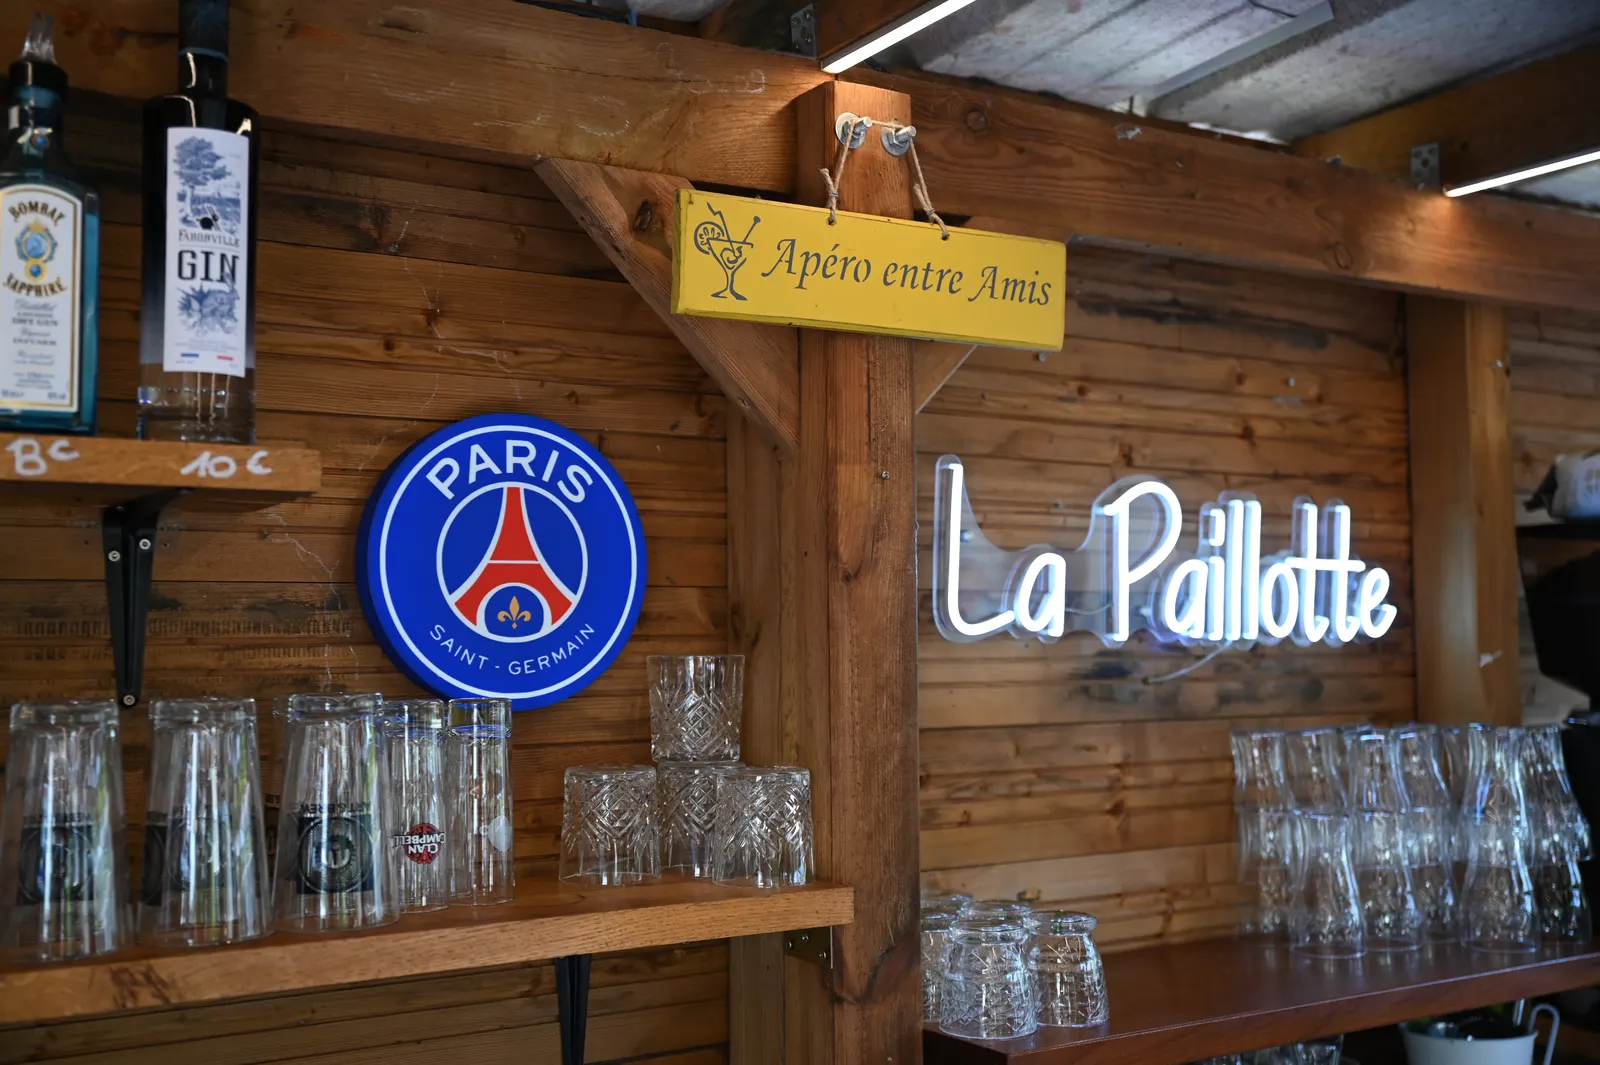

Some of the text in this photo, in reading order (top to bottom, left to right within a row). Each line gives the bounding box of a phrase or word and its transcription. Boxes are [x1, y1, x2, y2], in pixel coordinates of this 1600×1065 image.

[8, 200, 66, 227] BOMBAY
[3, 271, 68, 298] SAPPHIRE
[177, 249, 240, 285] GIN
[760, 238, 1052, 306] Apéro entre Amis
[425, 439, 594, 504] PARIS
[947, 463, 1398, 643] La Paillotte
[429, 624, 489, 670] SAINT
[508, 623, 595, 675] GERMAIN
[393, 832, 447, 845] CAMPBELL
[408, 842, 439, 854] CLAN
